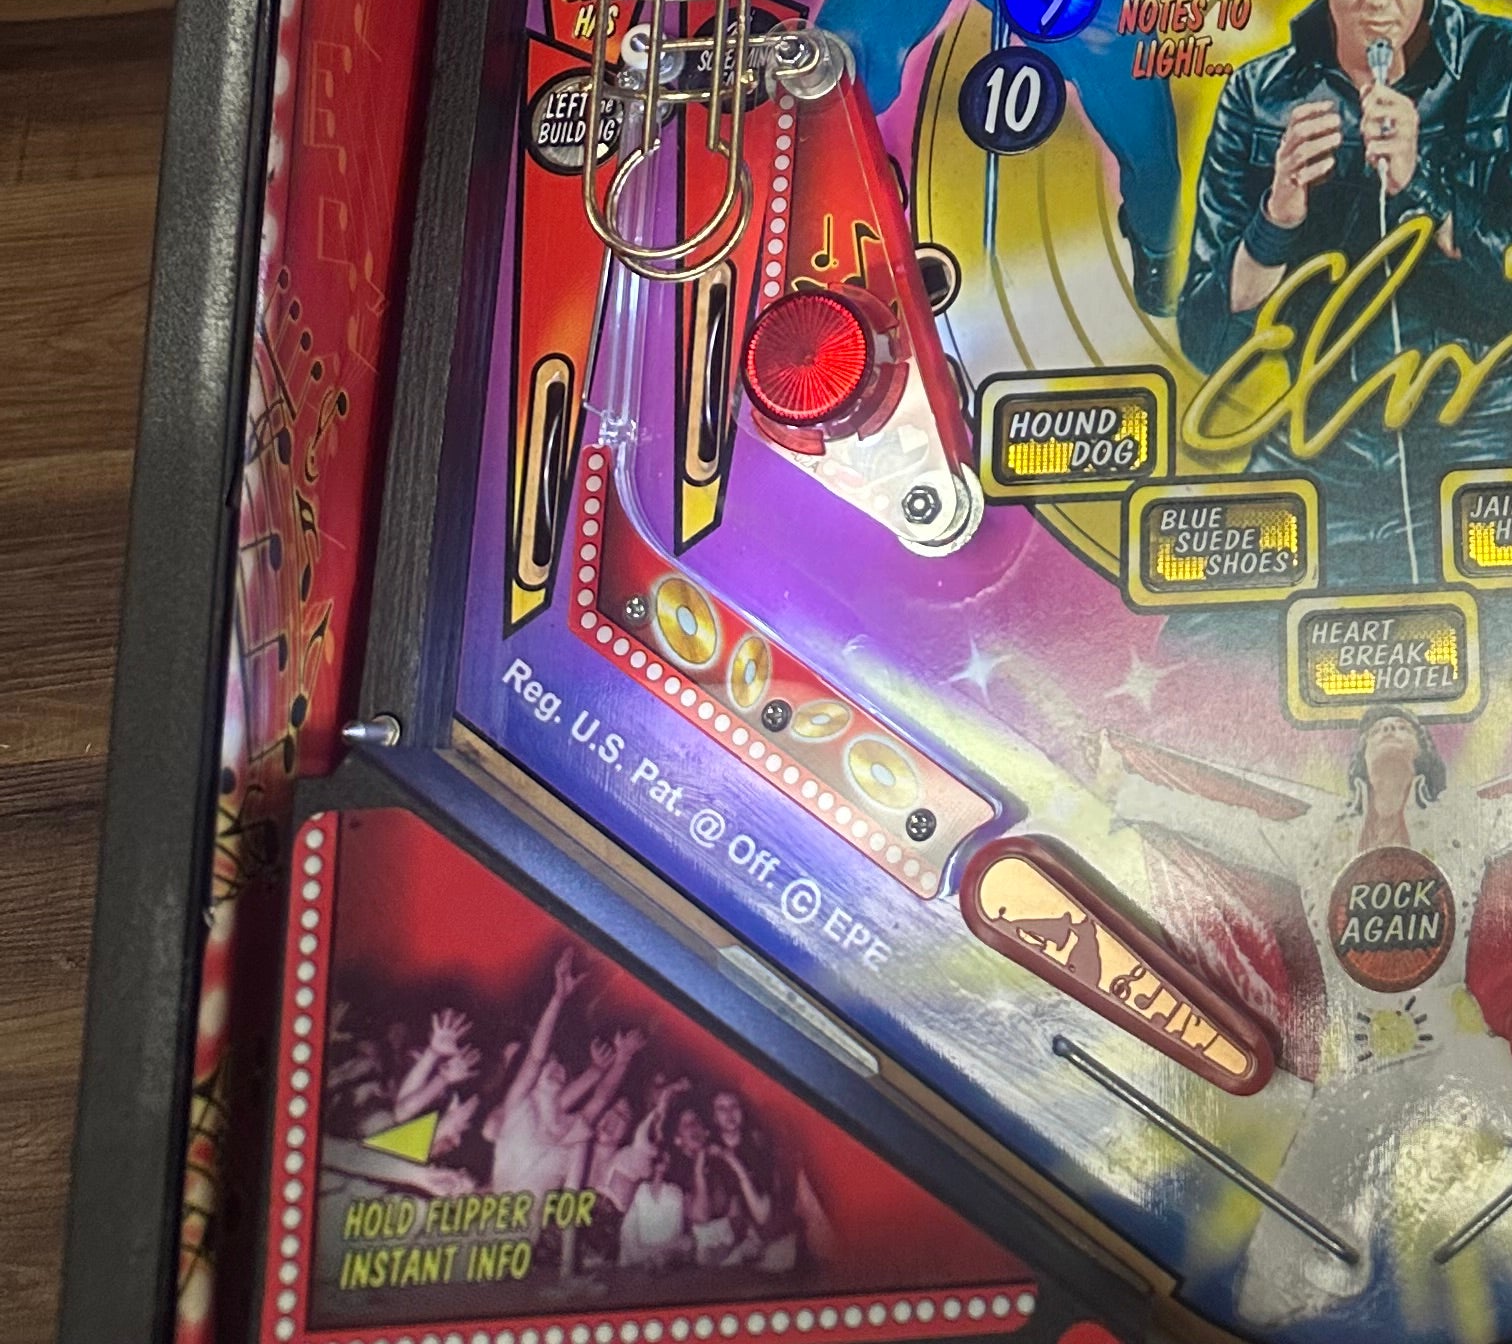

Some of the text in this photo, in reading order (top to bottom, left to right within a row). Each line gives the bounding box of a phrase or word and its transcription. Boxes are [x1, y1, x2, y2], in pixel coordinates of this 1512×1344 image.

[545, 93, 588, 120] LEFT
[983, 65, 1042, 135] 10
[1009, 407, 1118, 442] HOUND
[1070, 438, 1135, 469] DOG
[1160, 507, 1223, 532] BLUE
[1175, 528, 1256, 554] SUEDE
[1205, 552, 1289, 577] SHOES
[1311, 618, 1396, 645] HEART
[1338, 642, 1426, 669] BREAK
[1374, 664, 1455, 689] HOTEL
[501, 657, 892, 973] Reg. U.S. Pat. Off. EPE
[1348, 878, 1436, 914] ROCK
[1338, 909, 1442, 948] AGAIN
[343, 1188, 597, 1241] HOLD FLIPPER FOR
[339, 1240, 534, 1291] INSTANT INFO
